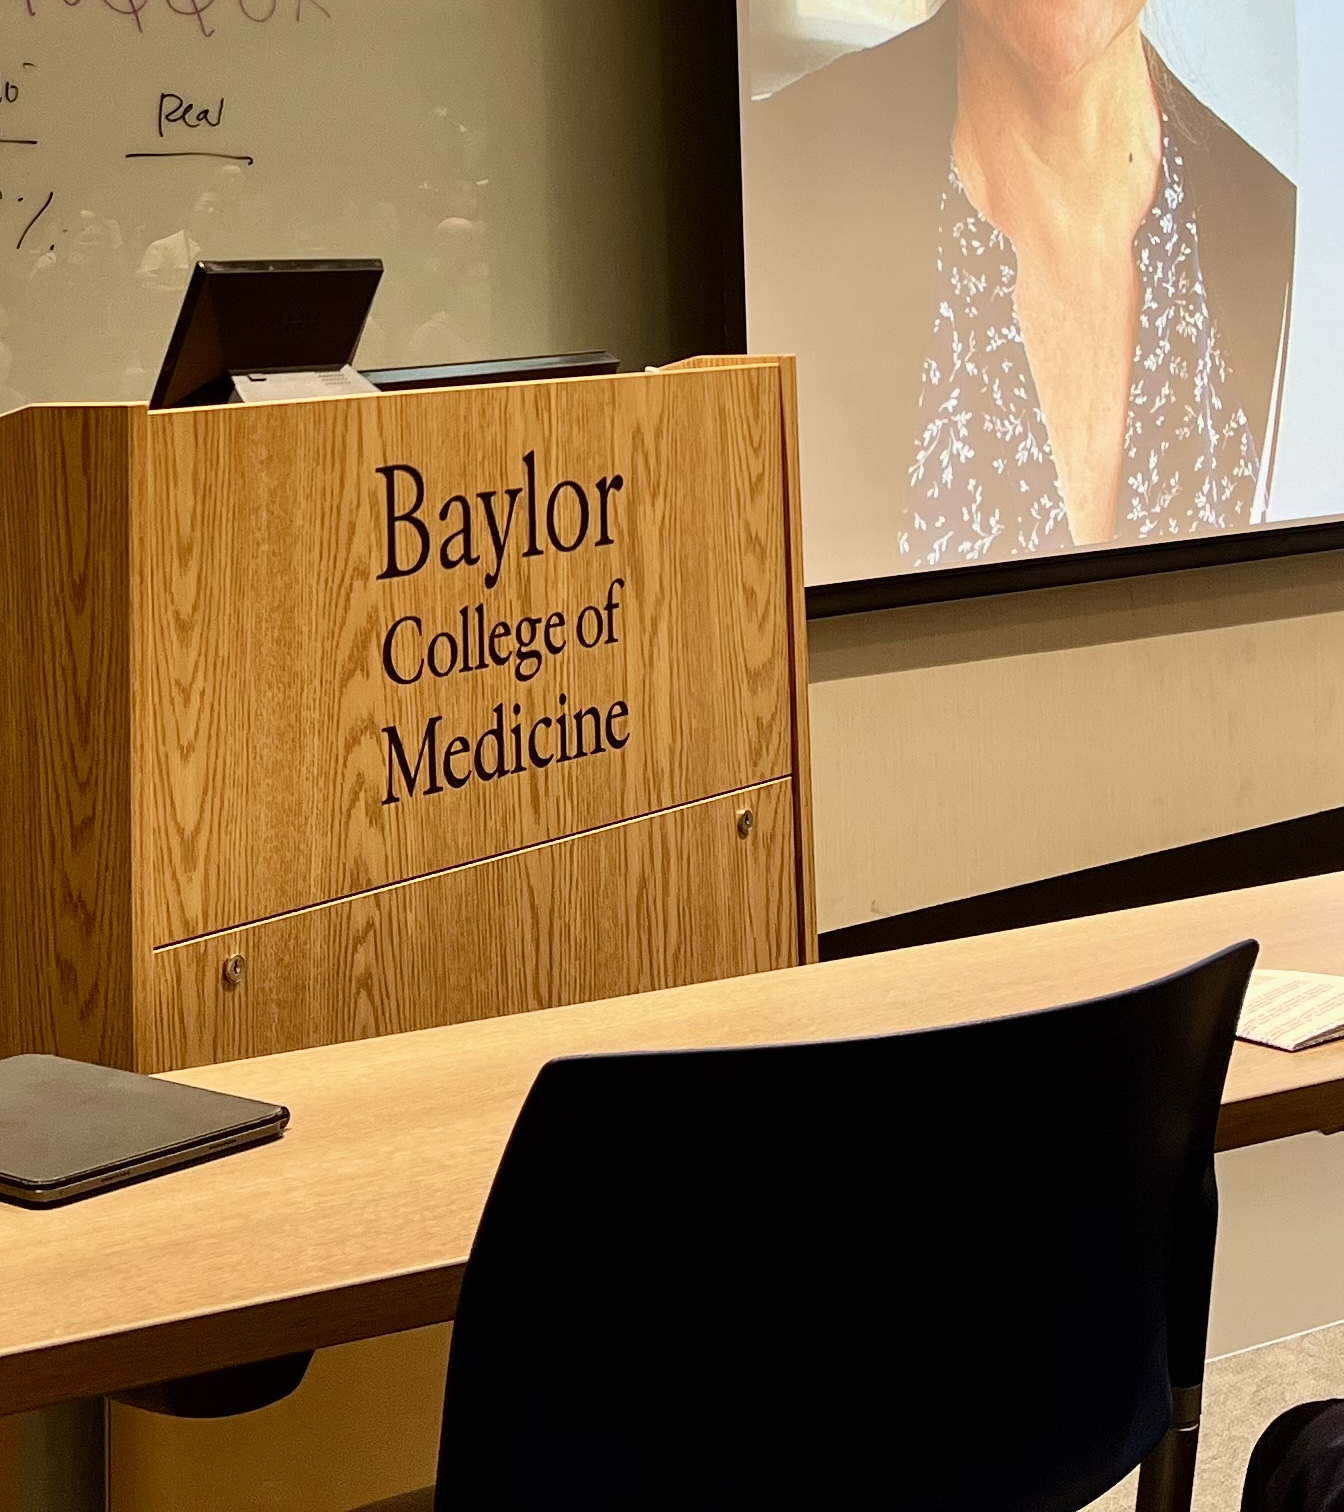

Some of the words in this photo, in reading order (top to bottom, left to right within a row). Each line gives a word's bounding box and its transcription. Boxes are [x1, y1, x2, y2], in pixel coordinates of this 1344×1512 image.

[375, 449, 623, 589] Baylor
[382, 603, 566, 685] College
[576, 577, 624, 649] of
[381, 693, 630, 805] Medicine
